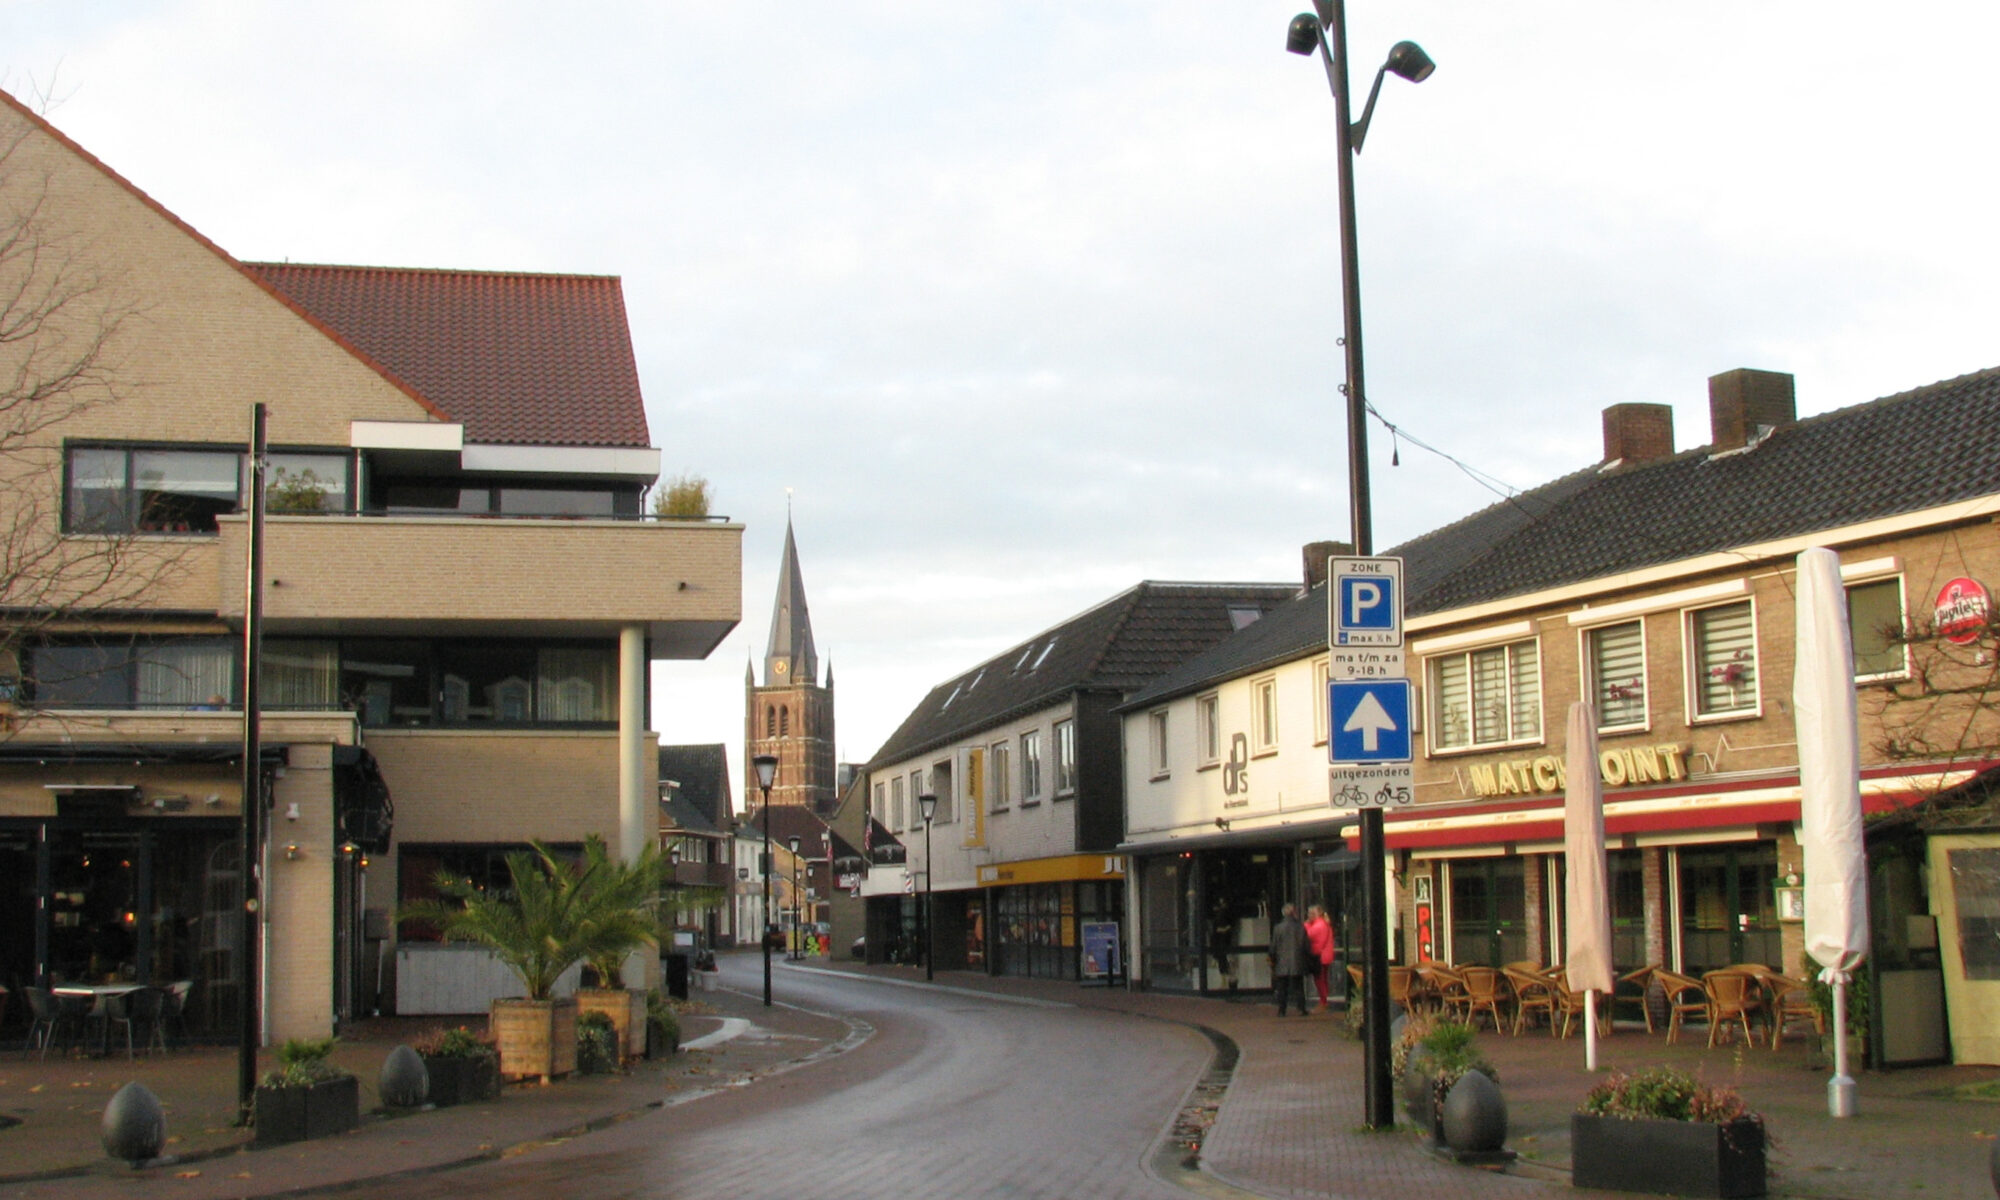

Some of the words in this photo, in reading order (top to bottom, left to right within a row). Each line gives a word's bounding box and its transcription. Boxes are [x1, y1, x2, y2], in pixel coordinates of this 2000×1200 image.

[1350, 563, 1382, 573] ZONE
[1351, 582, 1381, 624] P
[1350, 635, 1373, 643] max
[1385, 634, 1392, 643] h
[1335, 654, 1354, 663] ma
[1358, 652, 1379, 663] t/m
[1385, 654, 1398, 663] za
[1347, 665, 1375, 675] 9-18
[1379, 664, 1386, 675] h
[1600, 743, 1686, 787] OINT
[1331, 768, 1410, 781] uitgezonderd
